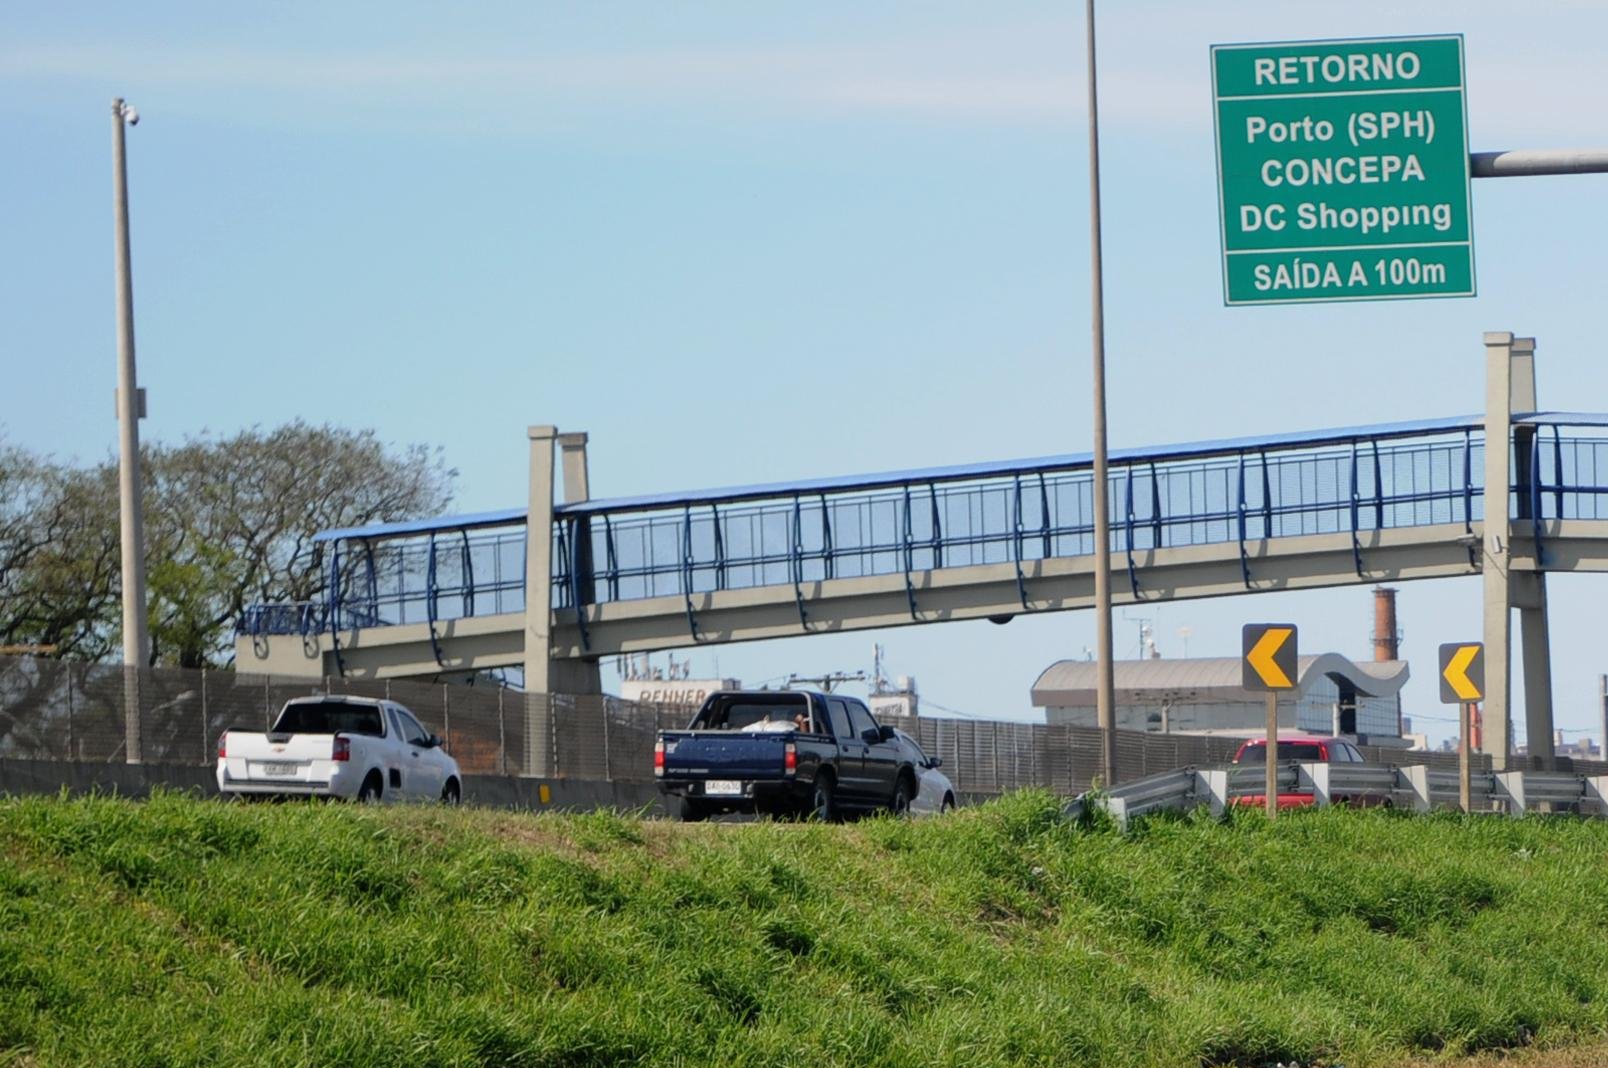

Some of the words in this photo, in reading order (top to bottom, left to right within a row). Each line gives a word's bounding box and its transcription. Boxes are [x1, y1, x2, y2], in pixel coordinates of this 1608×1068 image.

[1254, 51, 1421, 85] RETORNO
[1246, 115, 1334, 144] Porto
[1347, 110, 1436, 146] (SPH)
[1261, 154, 1425, 187] CONCEPA
[1240, 204, 1286, 232] DC
[1297, 202, 1452, 233] Shopping
[1254, 257, 1343, 291] SAÍDA
[1348, 261, 1368, 287] A
[1374, 258, 1446, 286] 100m
